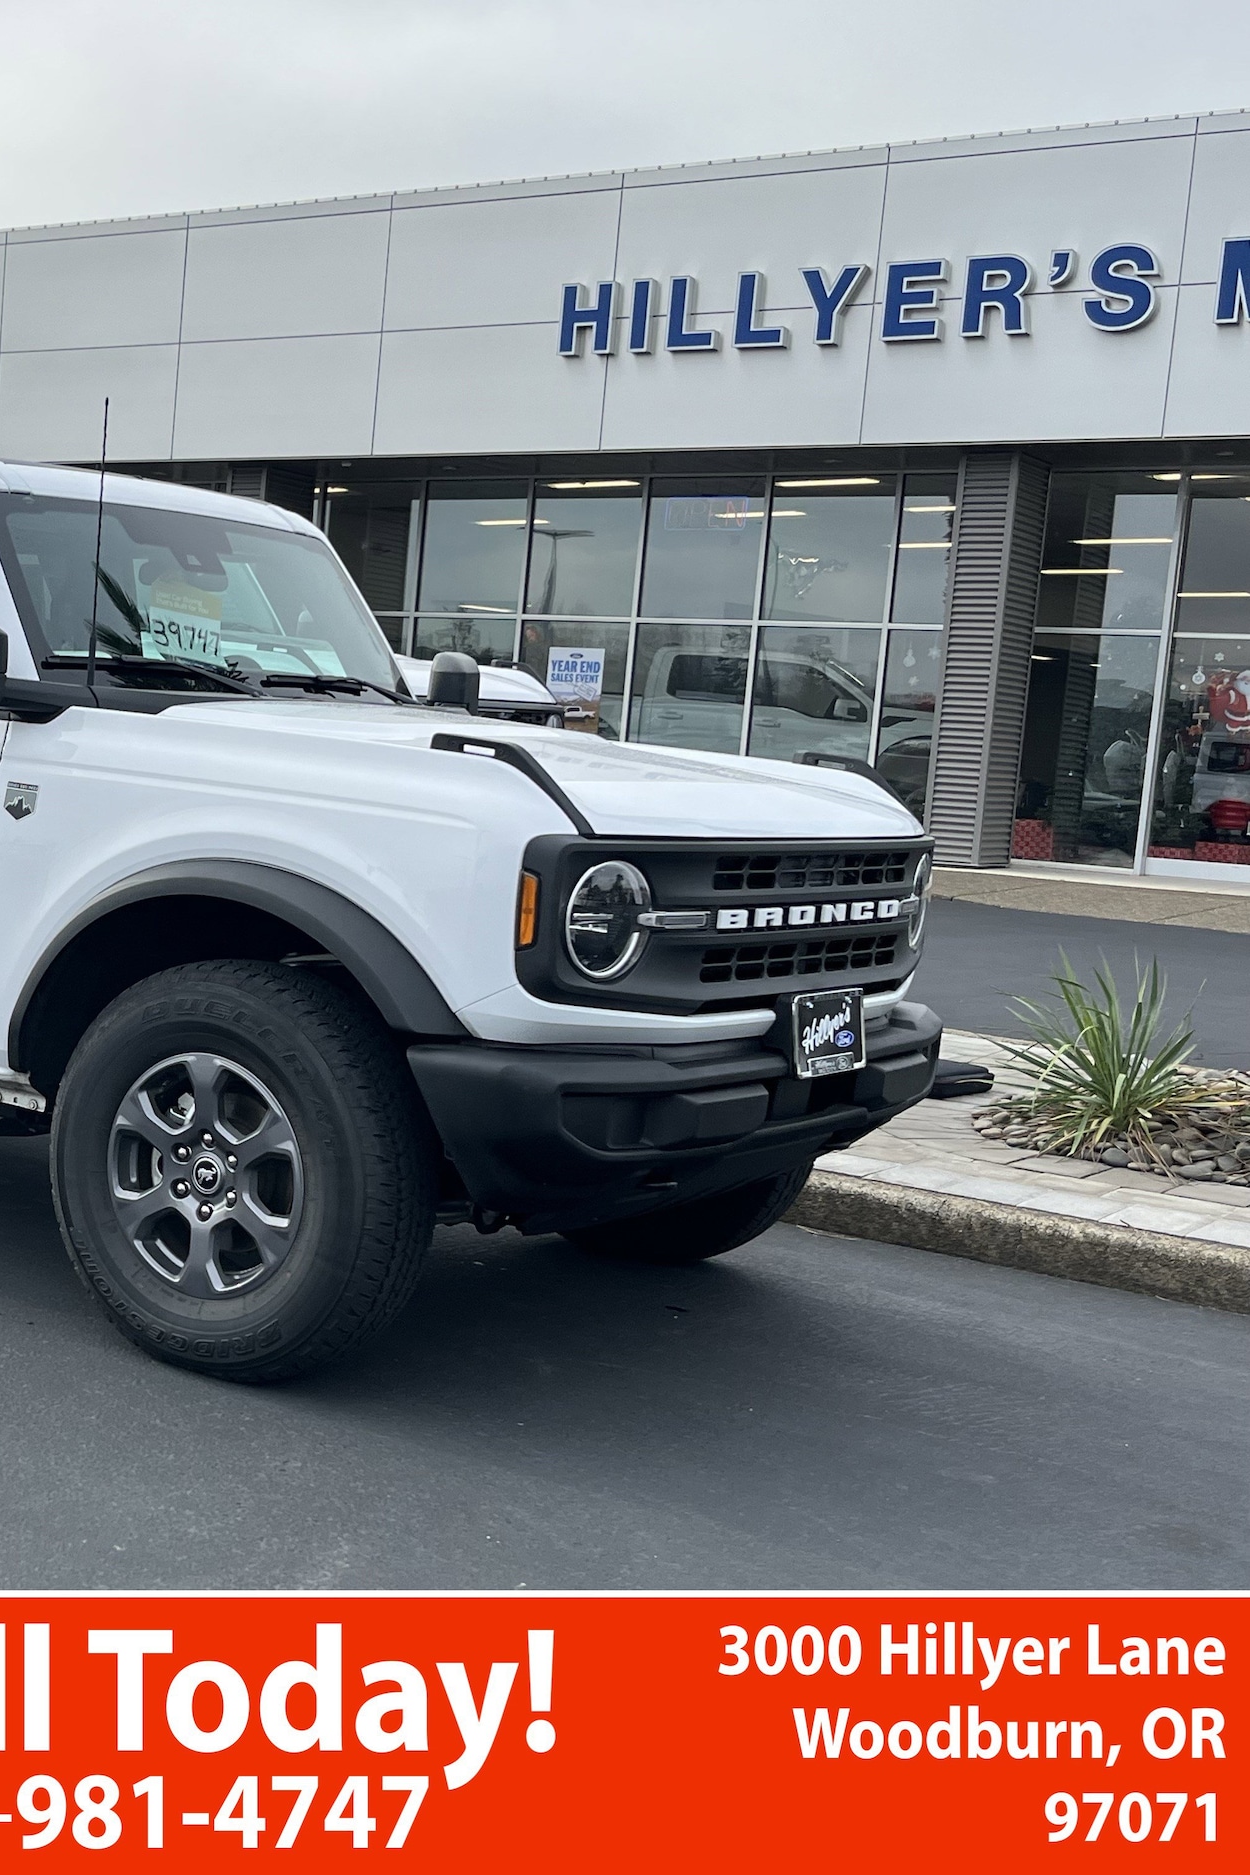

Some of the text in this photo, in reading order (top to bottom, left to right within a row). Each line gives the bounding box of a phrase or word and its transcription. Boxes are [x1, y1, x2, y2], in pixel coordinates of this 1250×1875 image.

[557, 241, 1161, 357] HILLYER'S
[550, 672, 599, 684] SALES EVENT
[551, 660, 601, 674] YEAR END
[716, 899, 900, 930] BRONCO
[801, 1002, 851, 1055] Hillyer's
